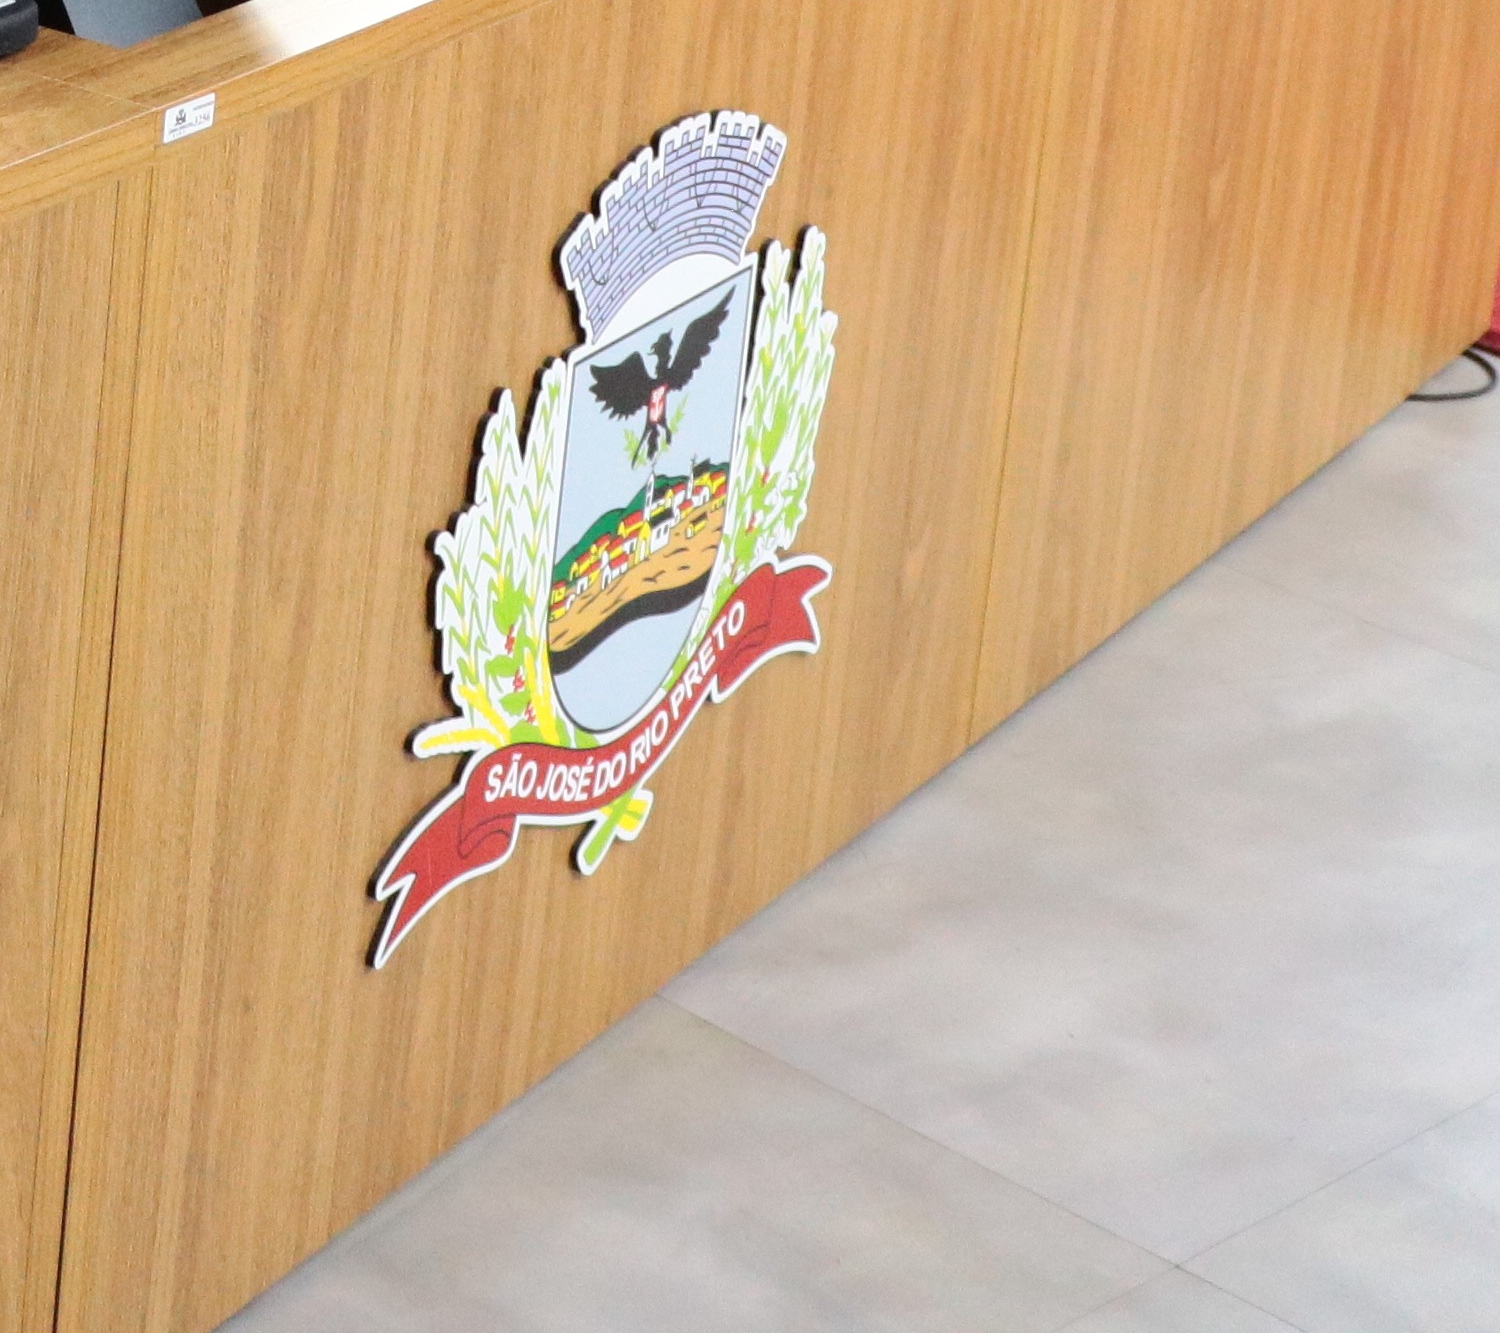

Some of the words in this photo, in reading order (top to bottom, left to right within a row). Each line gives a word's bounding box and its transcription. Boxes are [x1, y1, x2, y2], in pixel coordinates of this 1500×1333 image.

[484, 752, 538, 803] SÃO
[535, 756, 594, 802] JOSÉ
[593, 751, 627, 796] DO
[629, 709, 669, 774] RIO
[669, 600, 745, 721] PRETO
